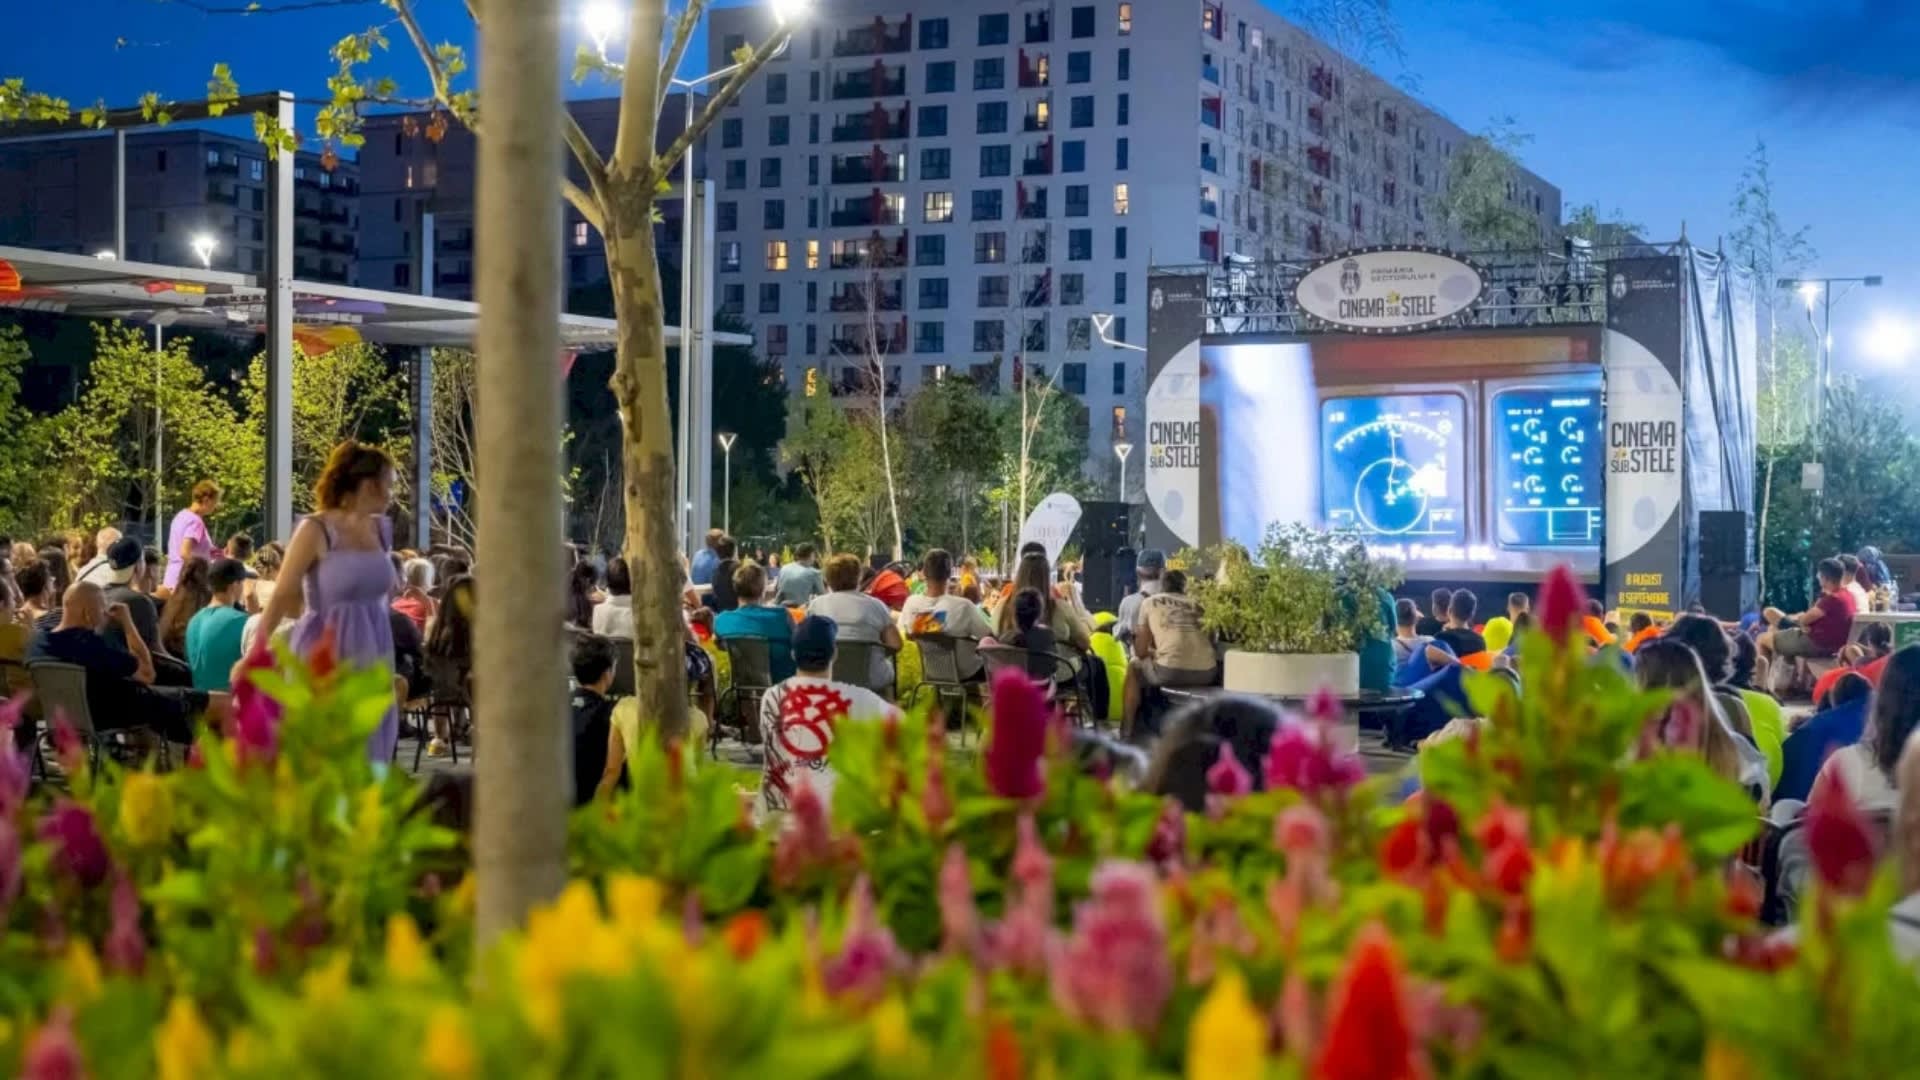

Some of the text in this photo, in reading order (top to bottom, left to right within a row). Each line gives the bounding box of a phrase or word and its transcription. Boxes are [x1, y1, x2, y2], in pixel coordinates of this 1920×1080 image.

[1340, 298, 1385, 319] CINEMA
[1402, 295, 1437, 316] STELE
[1611, 421, 1675, 447] CINEMA
[1611, 448, 1675, 473] SUB STELE
[1633, 573, 1663, 586] AUGUST
